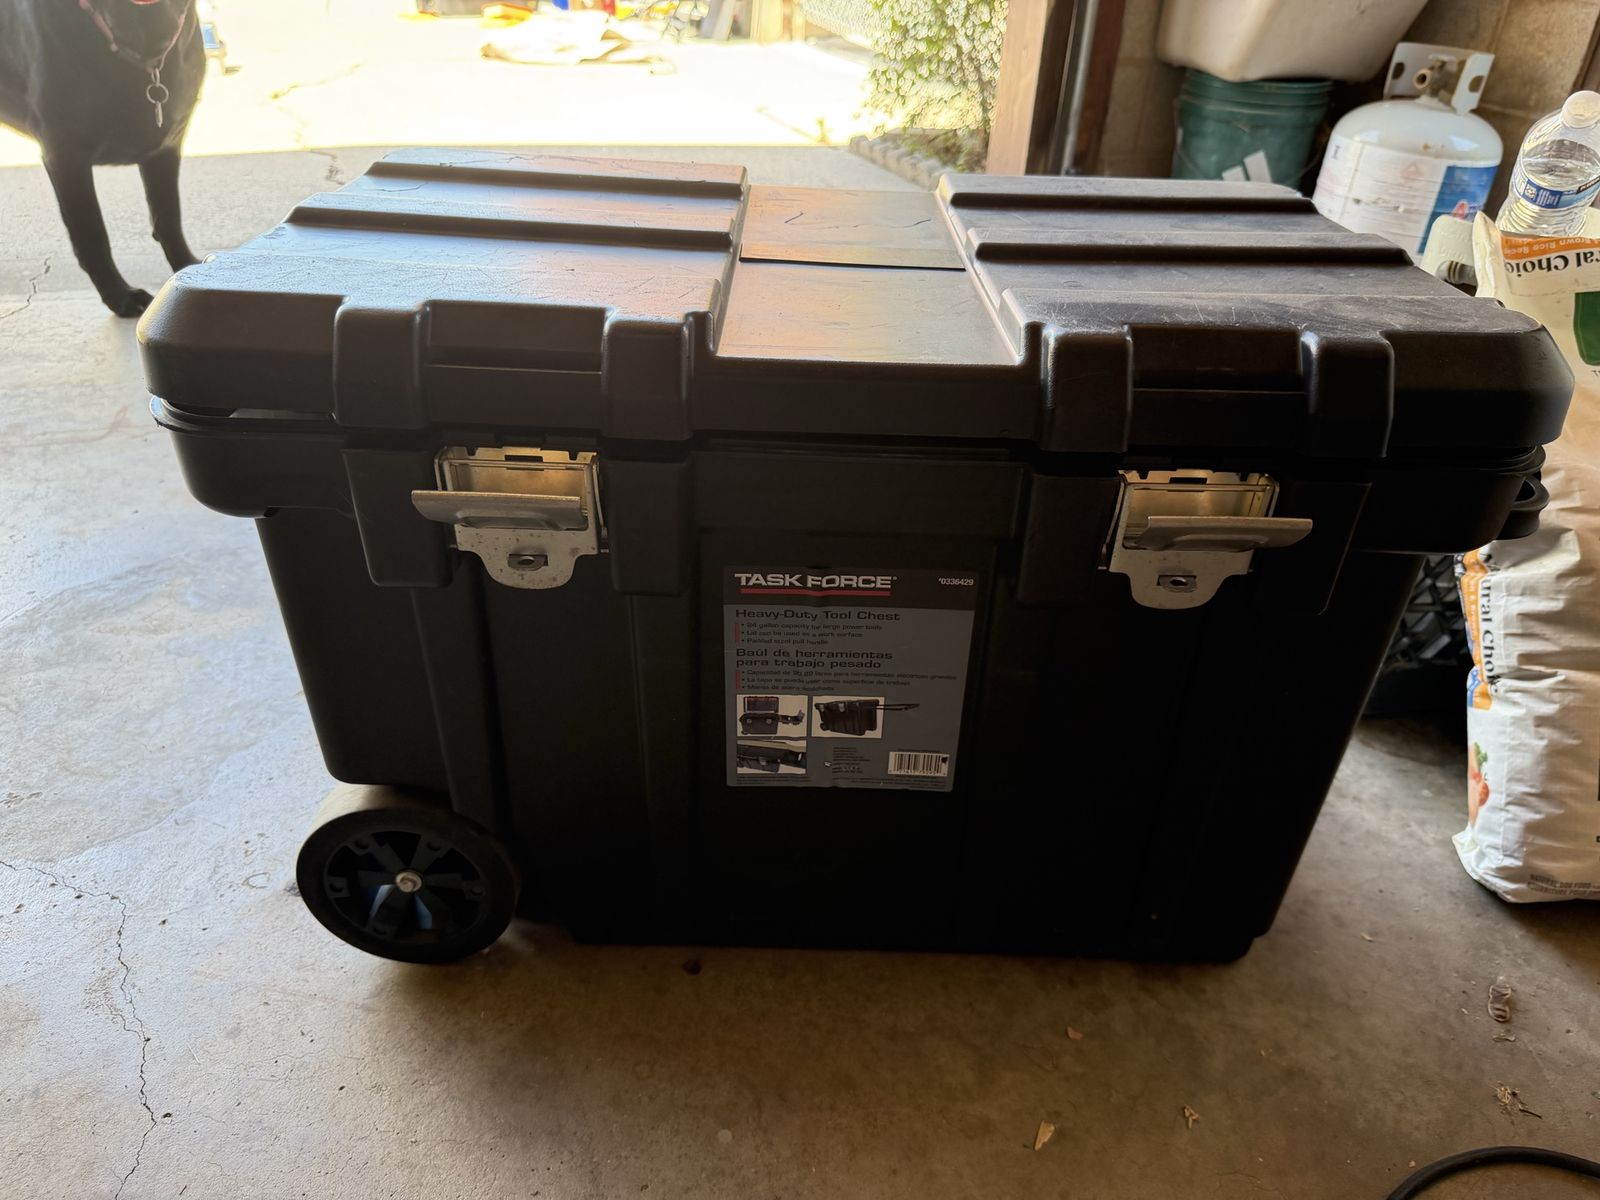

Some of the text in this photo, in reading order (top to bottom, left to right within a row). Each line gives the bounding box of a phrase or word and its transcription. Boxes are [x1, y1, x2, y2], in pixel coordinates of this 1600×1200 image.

[1532, 242, 1556, 251] Rice
[735, 573, 893, 589] TASK FORCE
[735, 609, 900, 622] Heavy-Duty Tool Chest
[758, 622, 779, 630] gallon
[736, 648, 893, 660] Baúl de herramientas
[736, 659, 881, 669] para trabajo pesado
